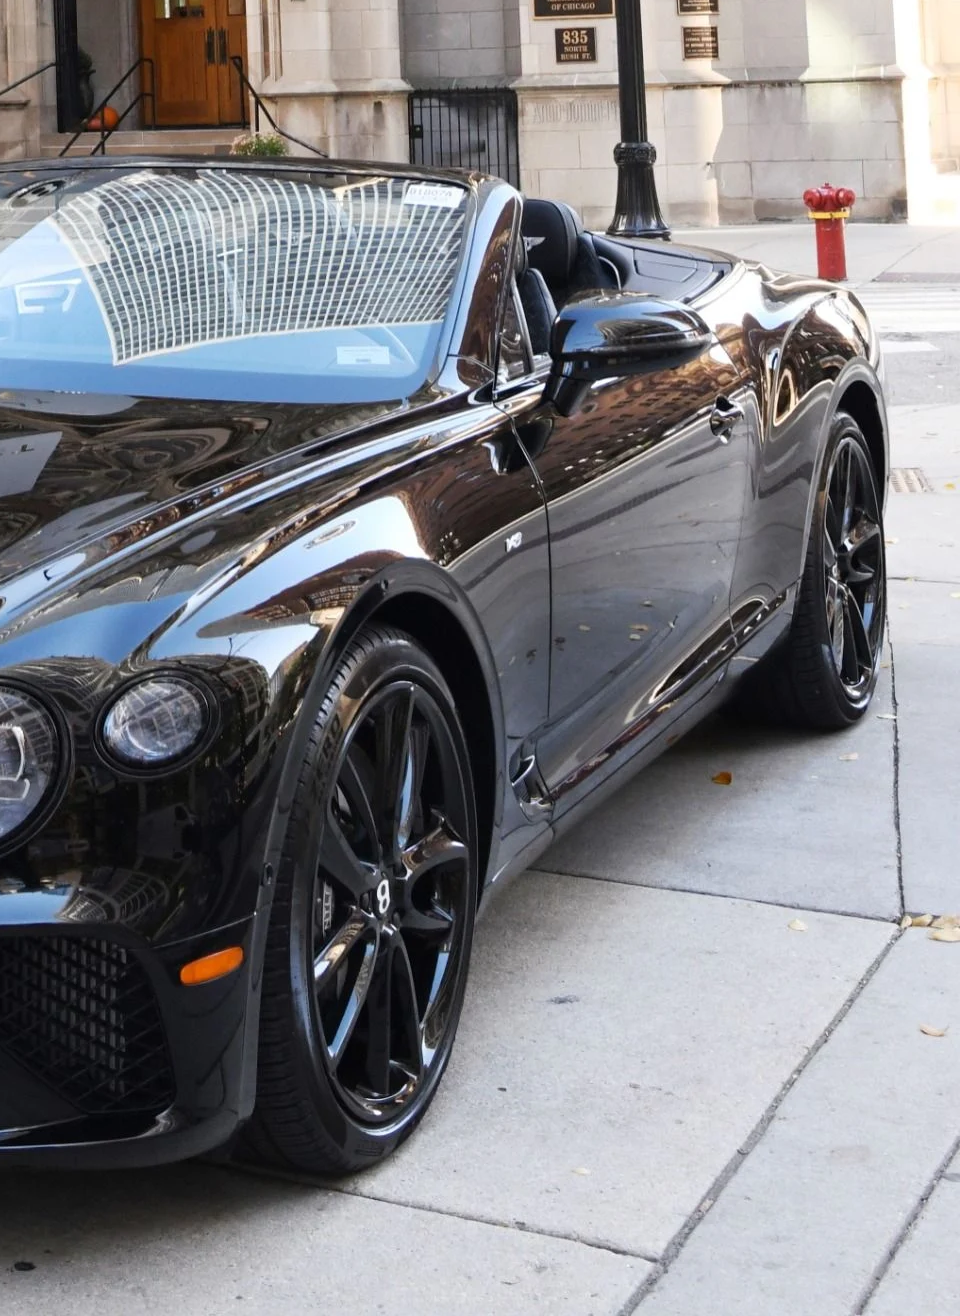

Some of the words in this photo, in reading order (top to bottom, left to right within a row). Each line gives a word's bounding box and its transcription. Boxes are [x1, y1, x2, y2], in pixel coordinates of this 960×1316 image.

[562, 3, 596, 11] CHICAGO
[562, 30, 588, 45] 835
[504, 531, 522, 553] V8
[376, 879, 390, 914] B
